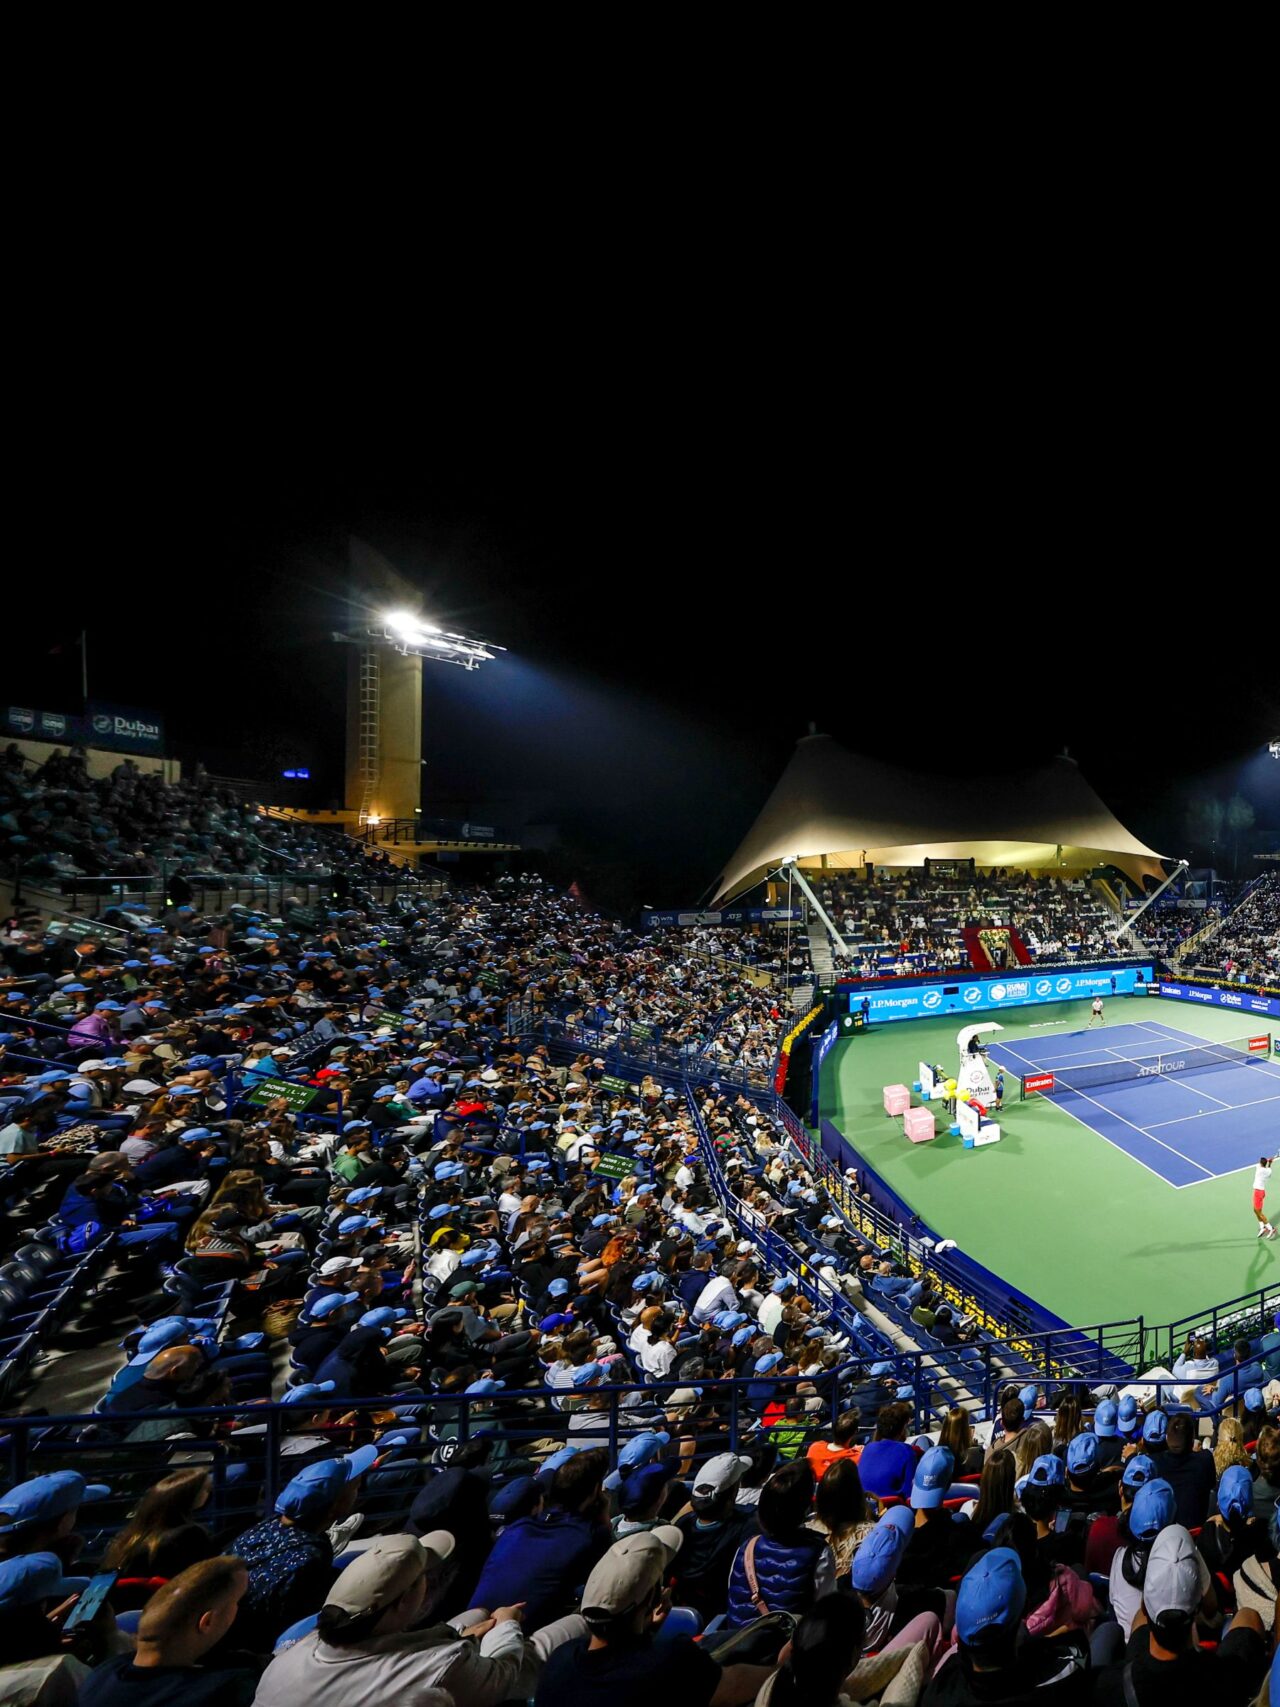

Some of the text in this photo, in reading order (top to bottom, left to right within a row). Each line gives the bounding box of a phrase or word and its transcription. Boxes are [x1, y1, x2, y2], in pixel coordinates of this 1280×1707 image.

[114, 716, 159, 734] Dubai
[1160, 1060, 1186, 1073] TOUR
[264, 1083, 287, 1092] ROWS
[1026, 1079, 1053, 1089] Emirates
